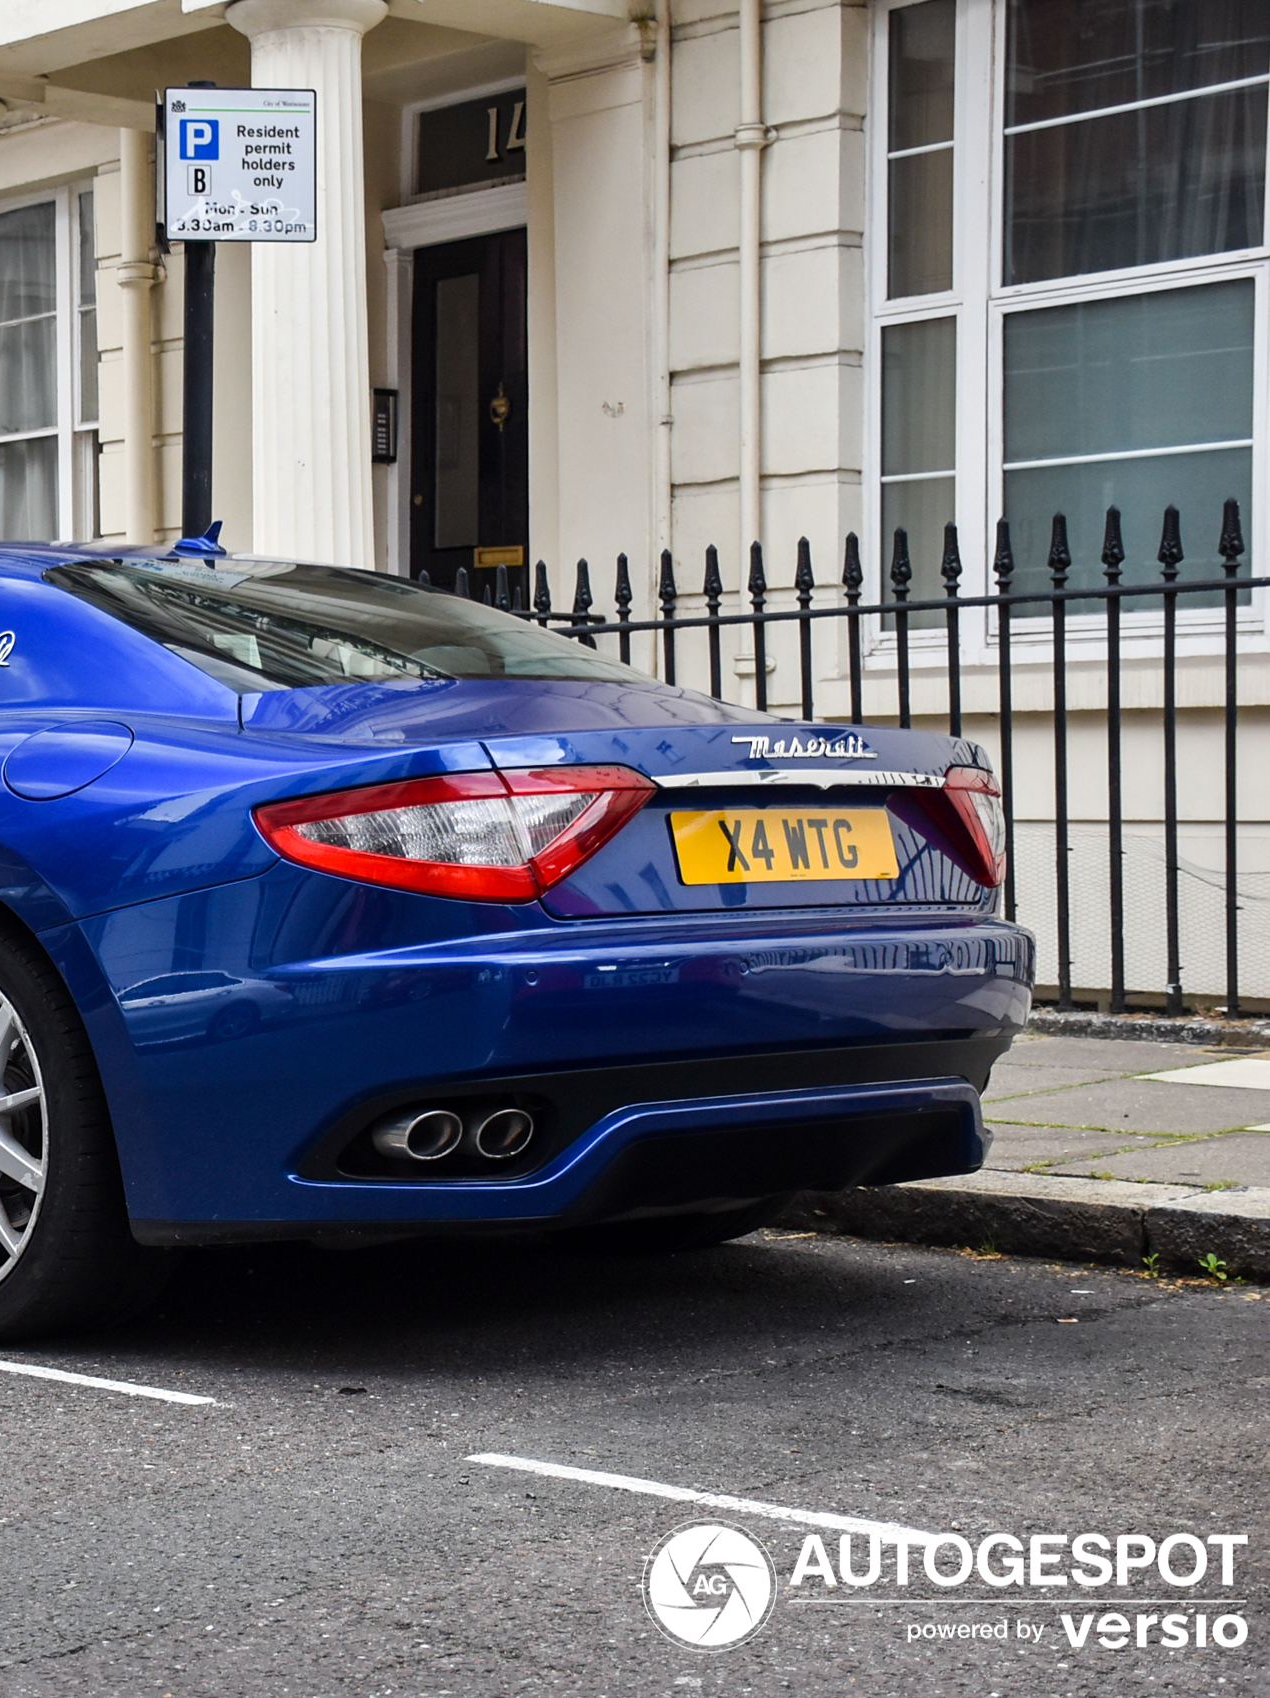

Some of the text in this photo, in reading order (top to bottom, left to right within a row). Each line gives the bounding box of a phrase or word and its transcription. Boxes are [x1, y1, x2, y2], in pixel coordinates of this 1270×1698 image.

[237, 125, 300, 138] Resident
[186, 122, 212, 157] P
[245, 142, 292, 156] permit
[242, 158, 295, 171] holders
[194, 168, 206, 193] B
[254, 175, 283, 189] only
[205, 202, 235, 215] Mon
[250, 203, 278, 215] Sun
[249, 220, 306, 234] 8.30pm
[731, 735, 878, 759] Maserati
[718, 818, 859, 872] X4 WTG
